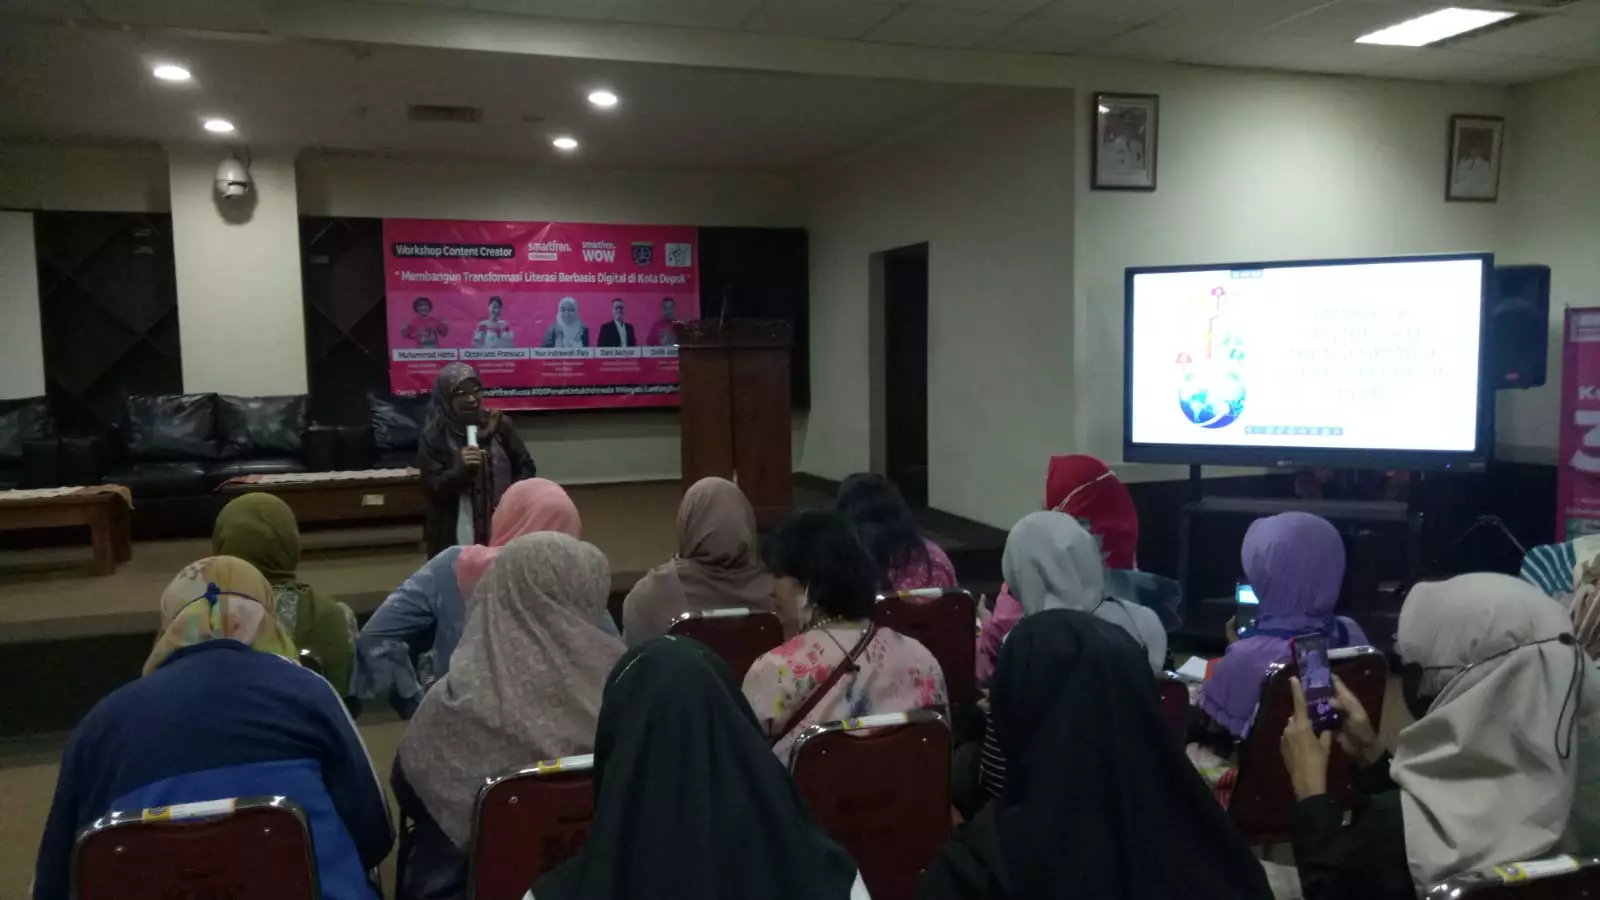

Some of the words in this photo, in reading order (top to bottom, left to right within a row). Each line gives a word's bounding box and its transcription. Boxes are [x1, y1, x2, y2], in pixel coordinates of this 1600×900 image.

[395, 244, 442, 257] Workshop
[444, 246, 479, 257] Content
[480, 247, 513, 257] Creator
[582, 249, 616, 262] WOW
[463, 271, 523, 283] Transformasi
[524, 272, 557, 283] Literasi
[558, 272, 596, 284] Berbasis
[597, 272, 627, 285] Digital
[628, 273, 637, 283] di
[638, 274, 658, 284] Kota
